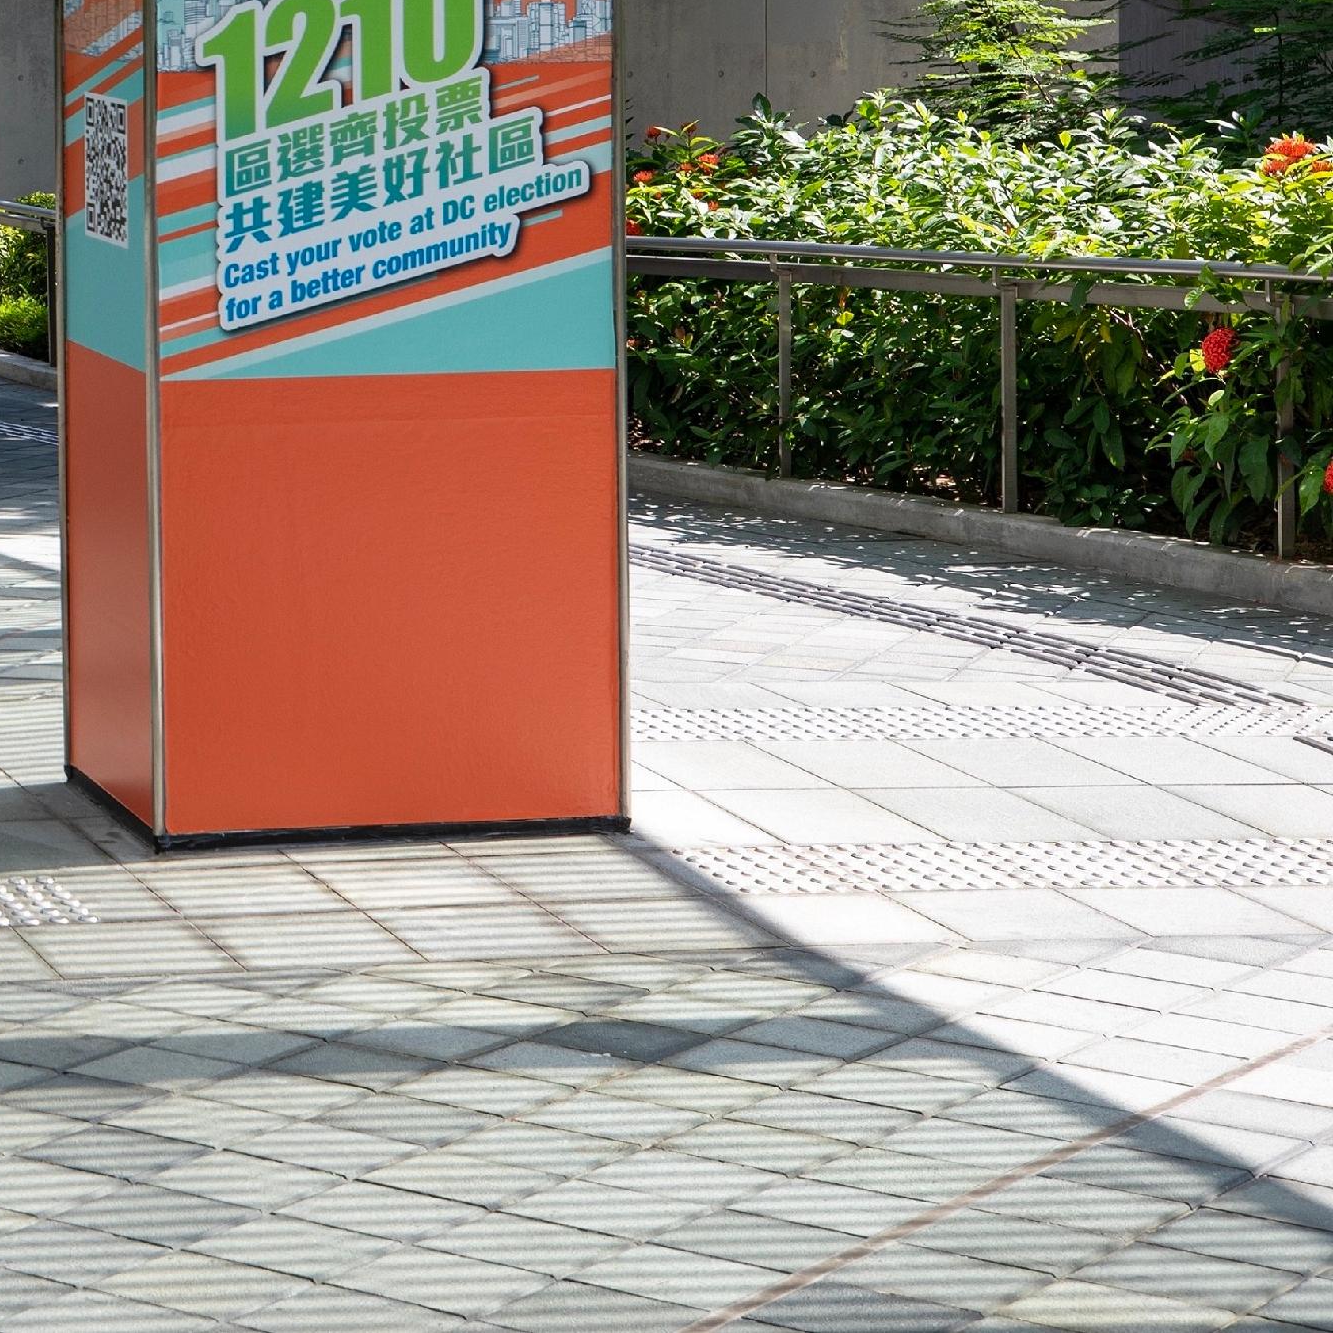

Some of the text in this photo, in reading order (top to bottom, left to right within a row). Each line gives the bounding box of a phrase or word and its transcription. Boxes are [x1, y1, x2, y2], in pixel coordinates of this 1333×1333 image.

[224, 115, 535, 253] 共建美好社區
[225, 76, 483, 198] 區選齊投票
[224, 165, 582, 289] Cast your vote at DC election
[225, 220, 512, 323] for a better community
